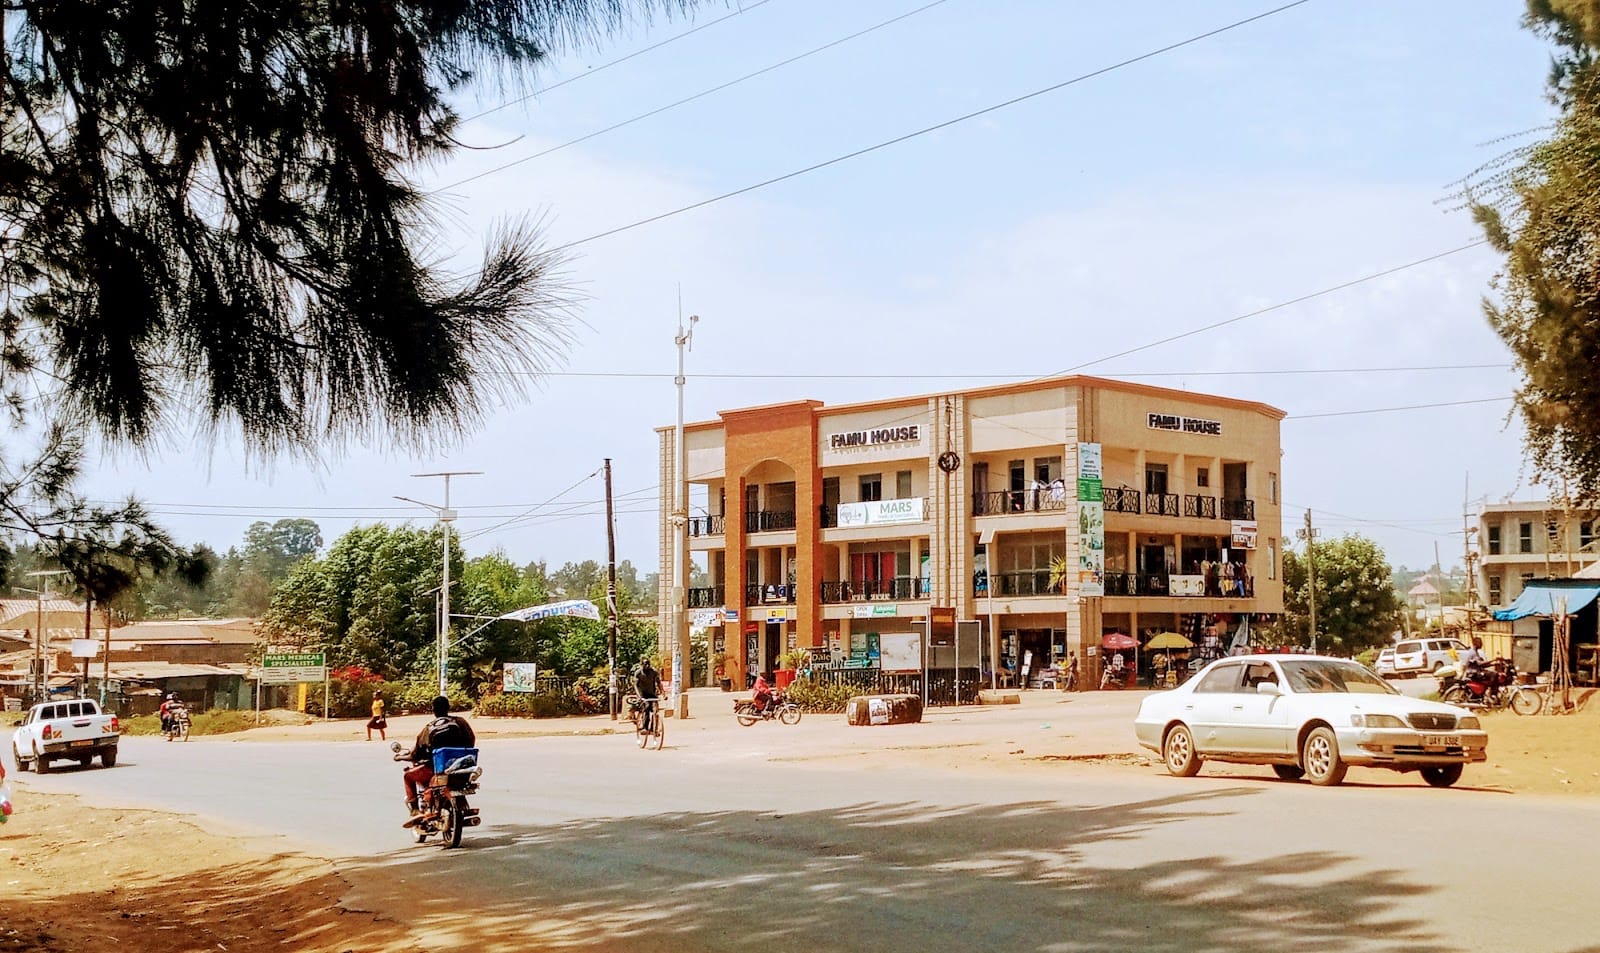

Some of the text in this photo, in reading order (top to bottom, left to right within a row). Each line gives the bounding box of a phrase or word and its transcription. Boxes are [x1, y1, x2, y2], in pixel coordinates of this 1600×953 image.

[1149, 414, 1221, 435] FAMU HOUSE
[831, 426, 918, 448] FAMU HOUSE
[880, 502, 912, 514] MARS
